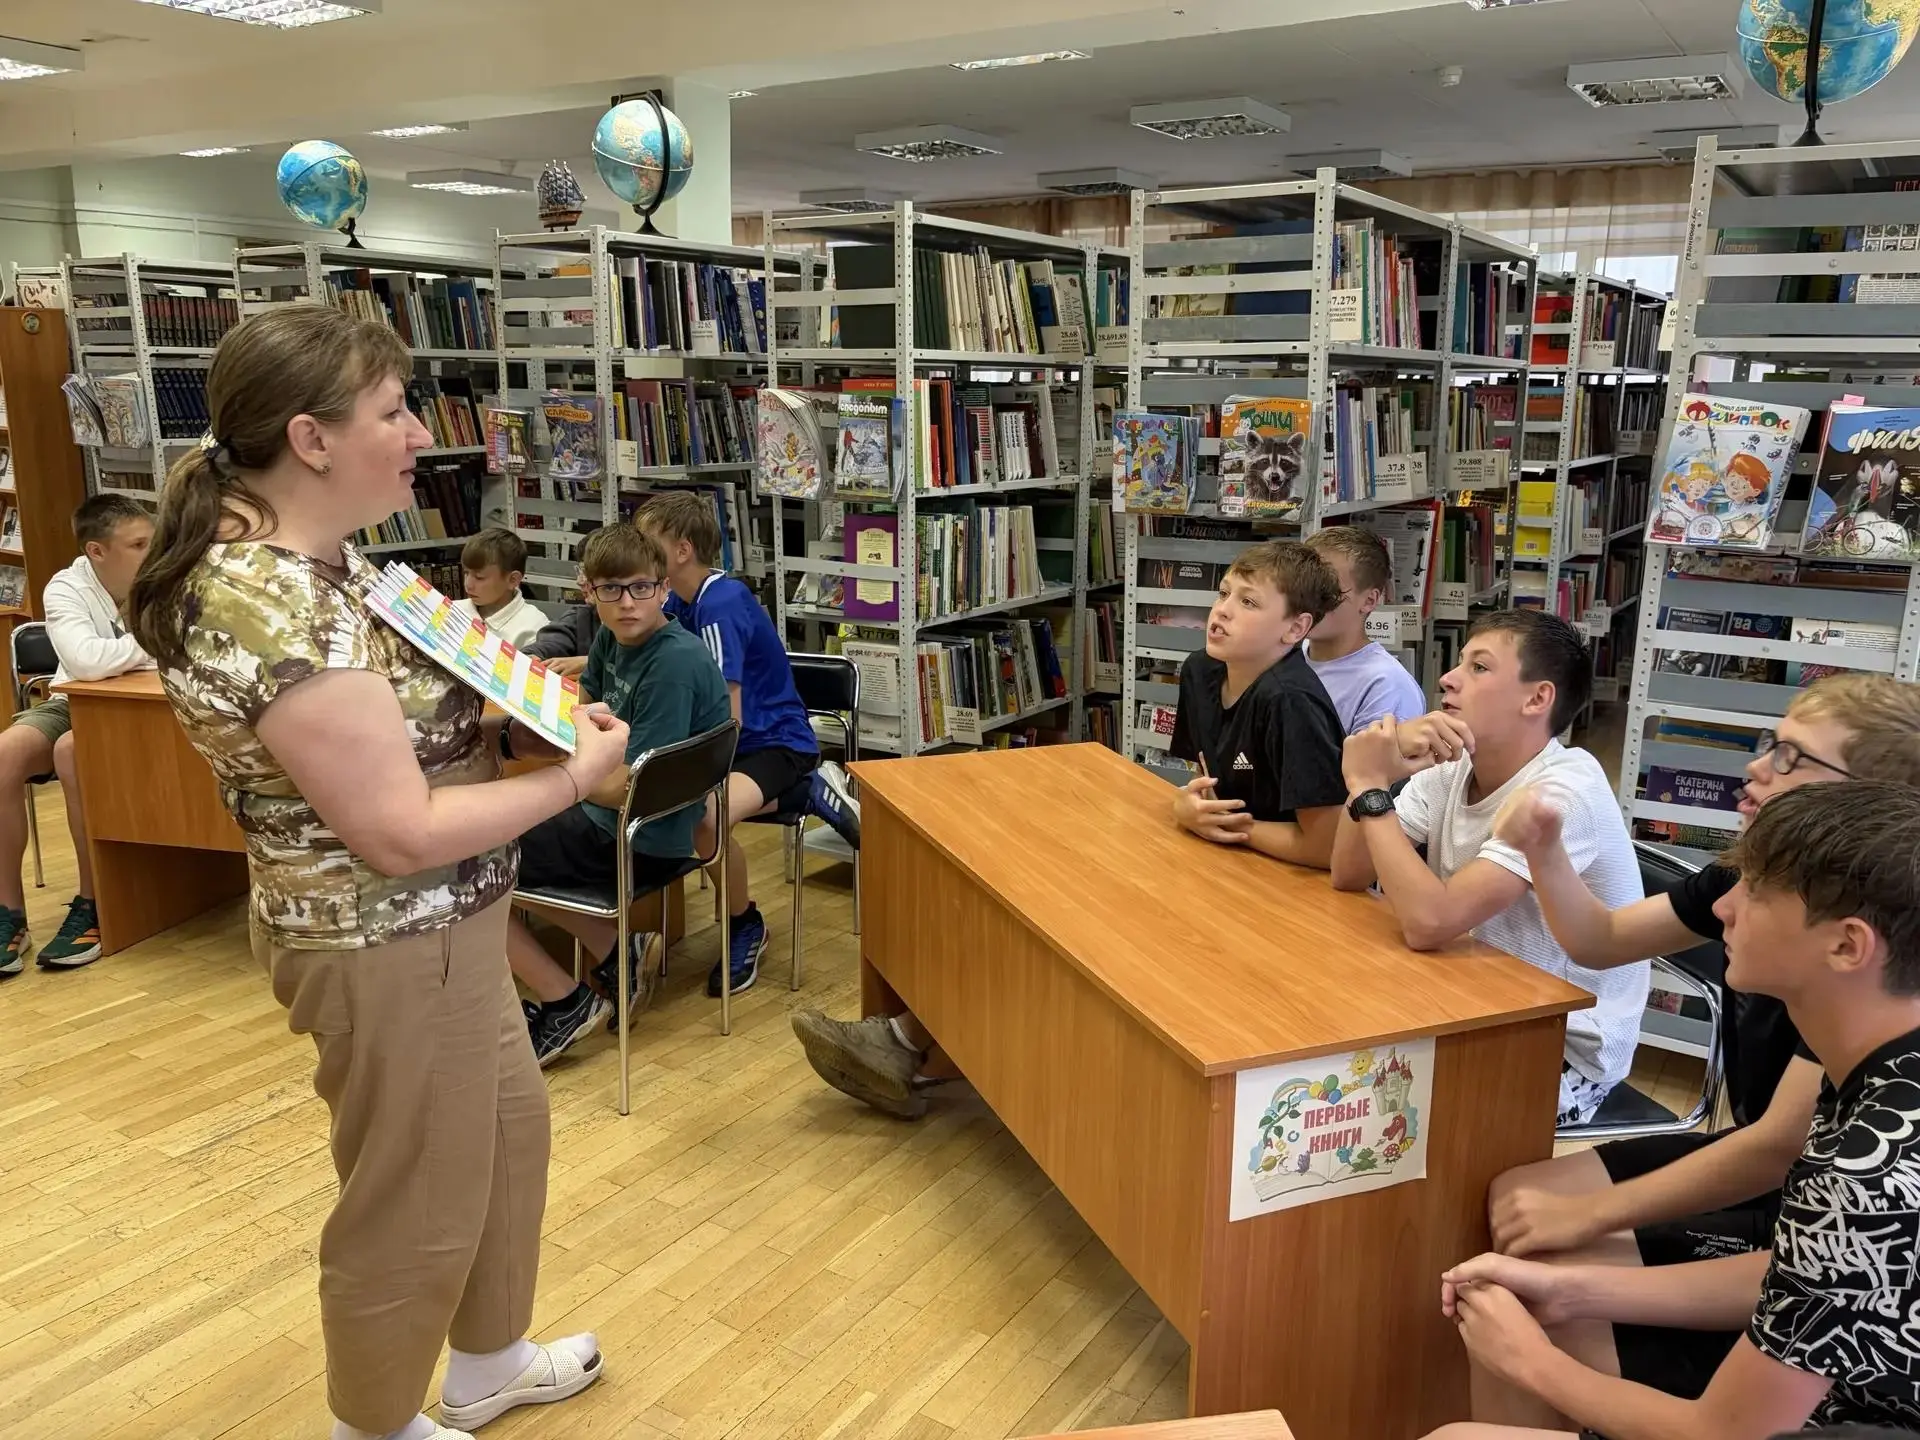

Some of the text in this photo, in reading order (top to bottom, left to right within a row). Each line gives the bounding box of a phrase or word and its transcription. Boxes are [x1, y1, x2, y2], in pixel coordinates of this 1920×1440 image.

[1387, 463, 1406, 473] 37.8
[849, 625, 899, 640] Атла
[1675, 775, 1725, 792] ЕКАТЕРИНА
[1678, 787, 1720, 802] ВЕЛИКАЯ
[1304, 1097, 1370, 1129] ПЕРВЫЕ
[1308, 1126, 1362, 1155] КНИГИ
